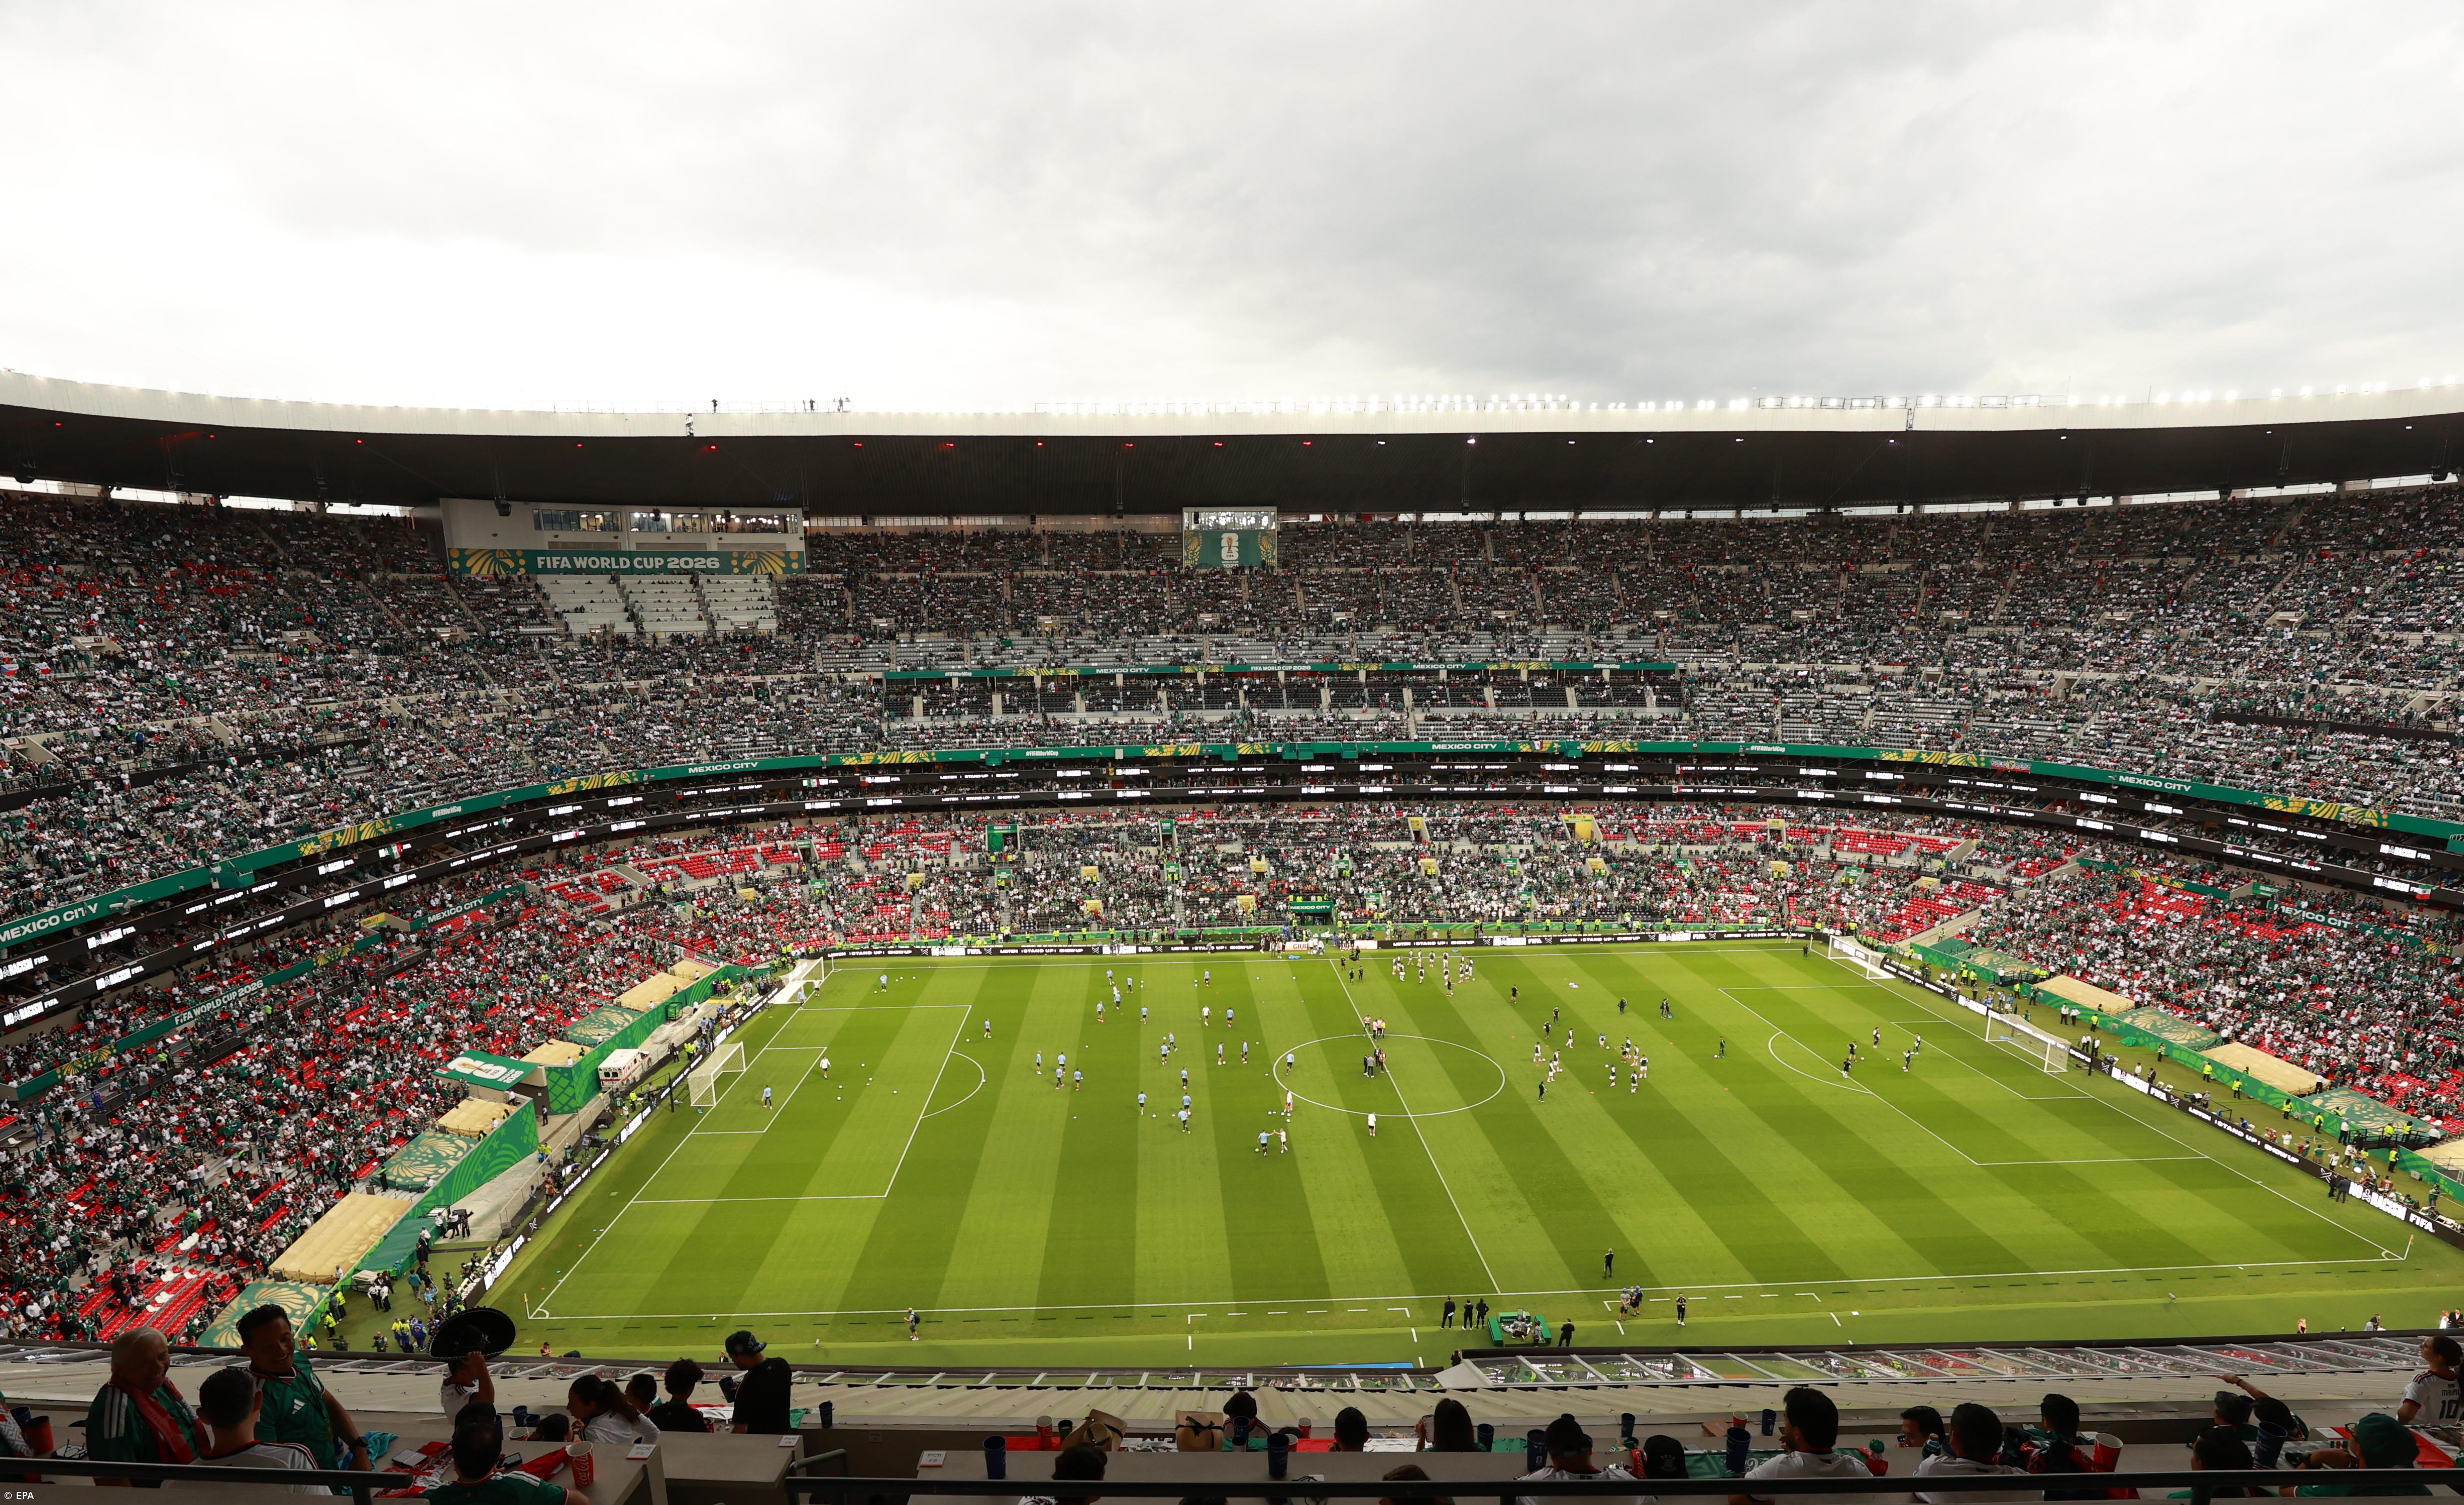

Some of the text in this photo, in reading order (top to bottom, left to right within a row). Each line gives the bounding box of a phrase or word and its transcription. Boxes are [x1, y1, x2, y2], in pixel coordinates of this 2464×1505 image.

[537, 556, 720, 569] FIFA WORLD CUP 2026
[688, 765, 731, 774] MEXICO
[2119, 775, 2192, 792] MEXICO CITY
[432, 805, 461, 818] #FIFAWorldCup
[2380, 844, 2389, 853] NO
[2393, 846, 2417, 858] RACISM
[427, 898, 484, 924] MEXICO CITY
[2274, 903, 2325, 923] MEXICO
[0, 902, 98, 942] MEXICO CITY
[122, 927, 135, 937] FIFA
[9, 955, 48, 976] RACISM FIFA
[96, 966, 144, 990] NO RACISM FIFA
[193, 999, 221, 1017] WORLD
[222, 992, 238, 1005] CUP
[238, 980, 264, 997] 2026
[4, 998, 58, 1026] NO RACISM FIFA
[503, 1070, 524, 1084] 2026
[2150, 1087, 2168, 1102] FIFA
[2245, 1134, 2258, 1143] UP
[2264, 1144, 2287, 1160] SHOW
[2287, 1155, 2299, 1164] UP
[2349, 1181, 2435, 1233] NO RACISM FIFA
[512, 1234, 525, 1252] FIFA
[2439, 1400, 2459, 1419] 10
[573, 1454, 589, 1487] Coca-Cola
